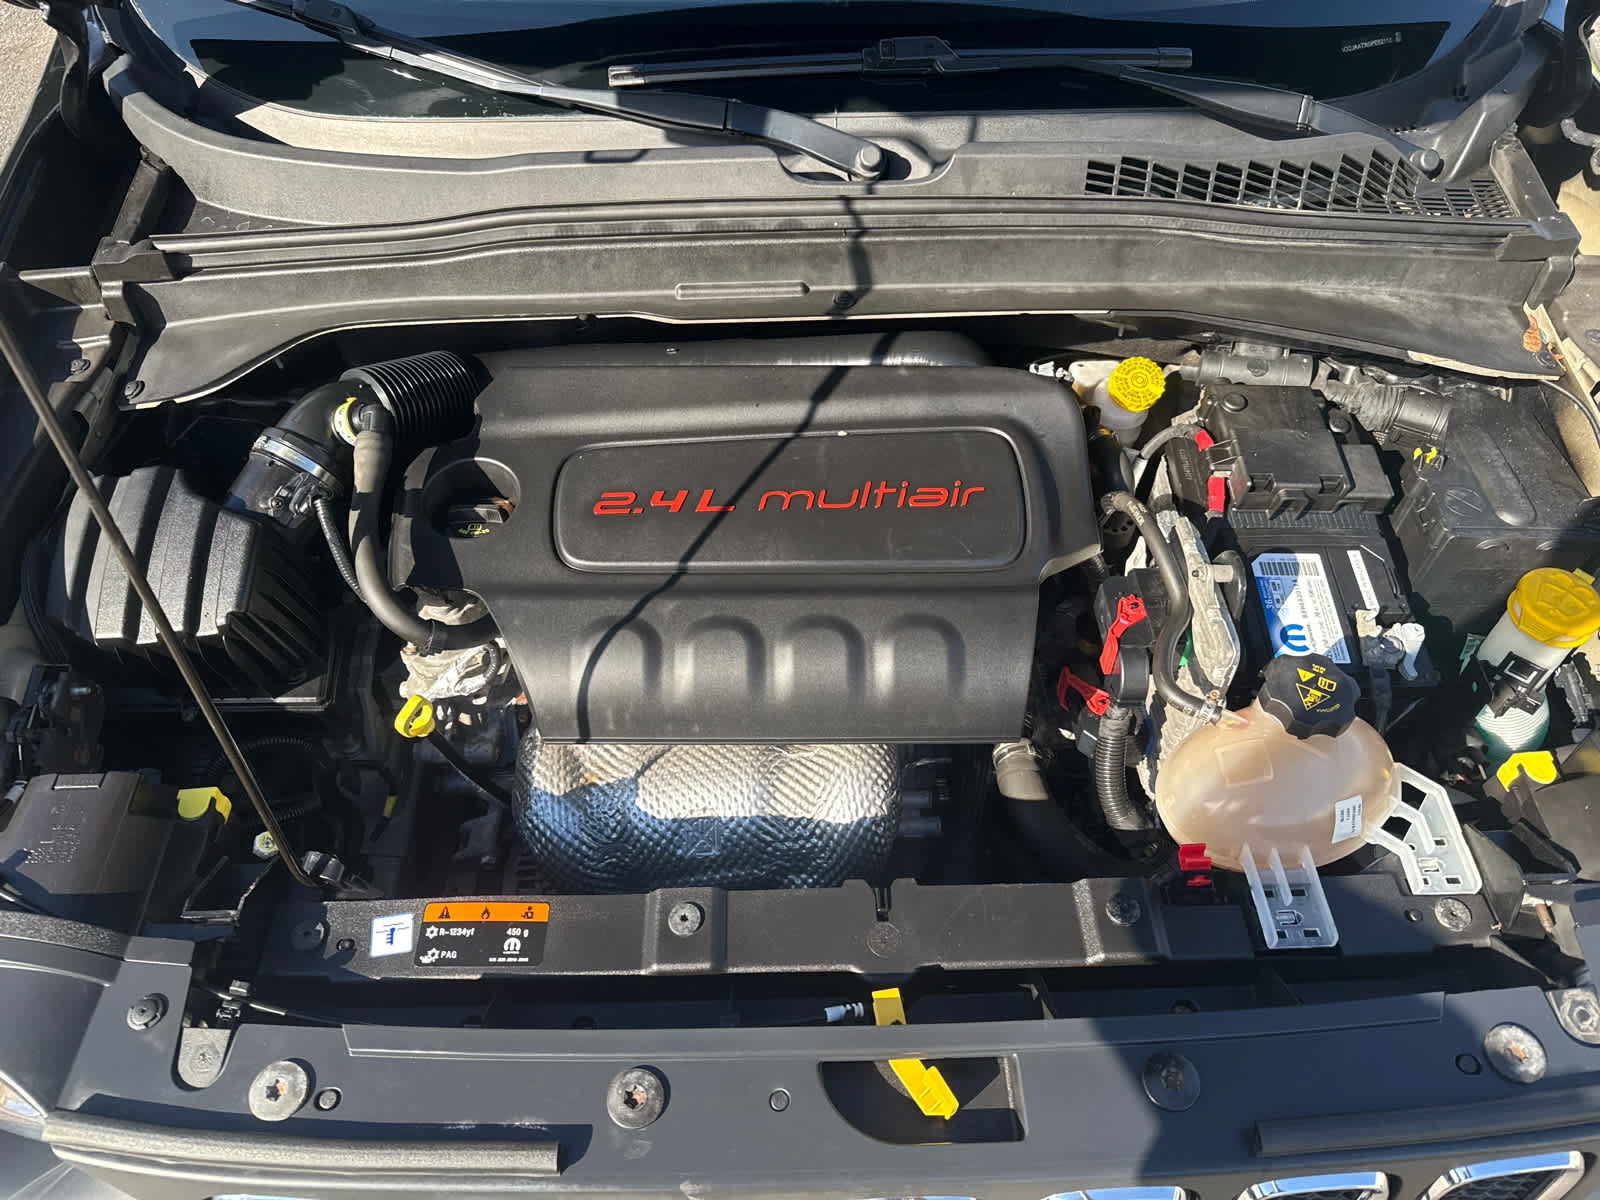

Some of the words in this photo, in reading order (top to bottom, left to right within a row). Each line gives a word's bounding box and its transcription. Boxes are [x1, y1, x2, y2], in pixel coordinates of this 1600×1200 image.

[757, 480, 985, 511] multiair
[439, 927, 475, 938] R-1234yf
[440, 950, 457, 959] PAG
